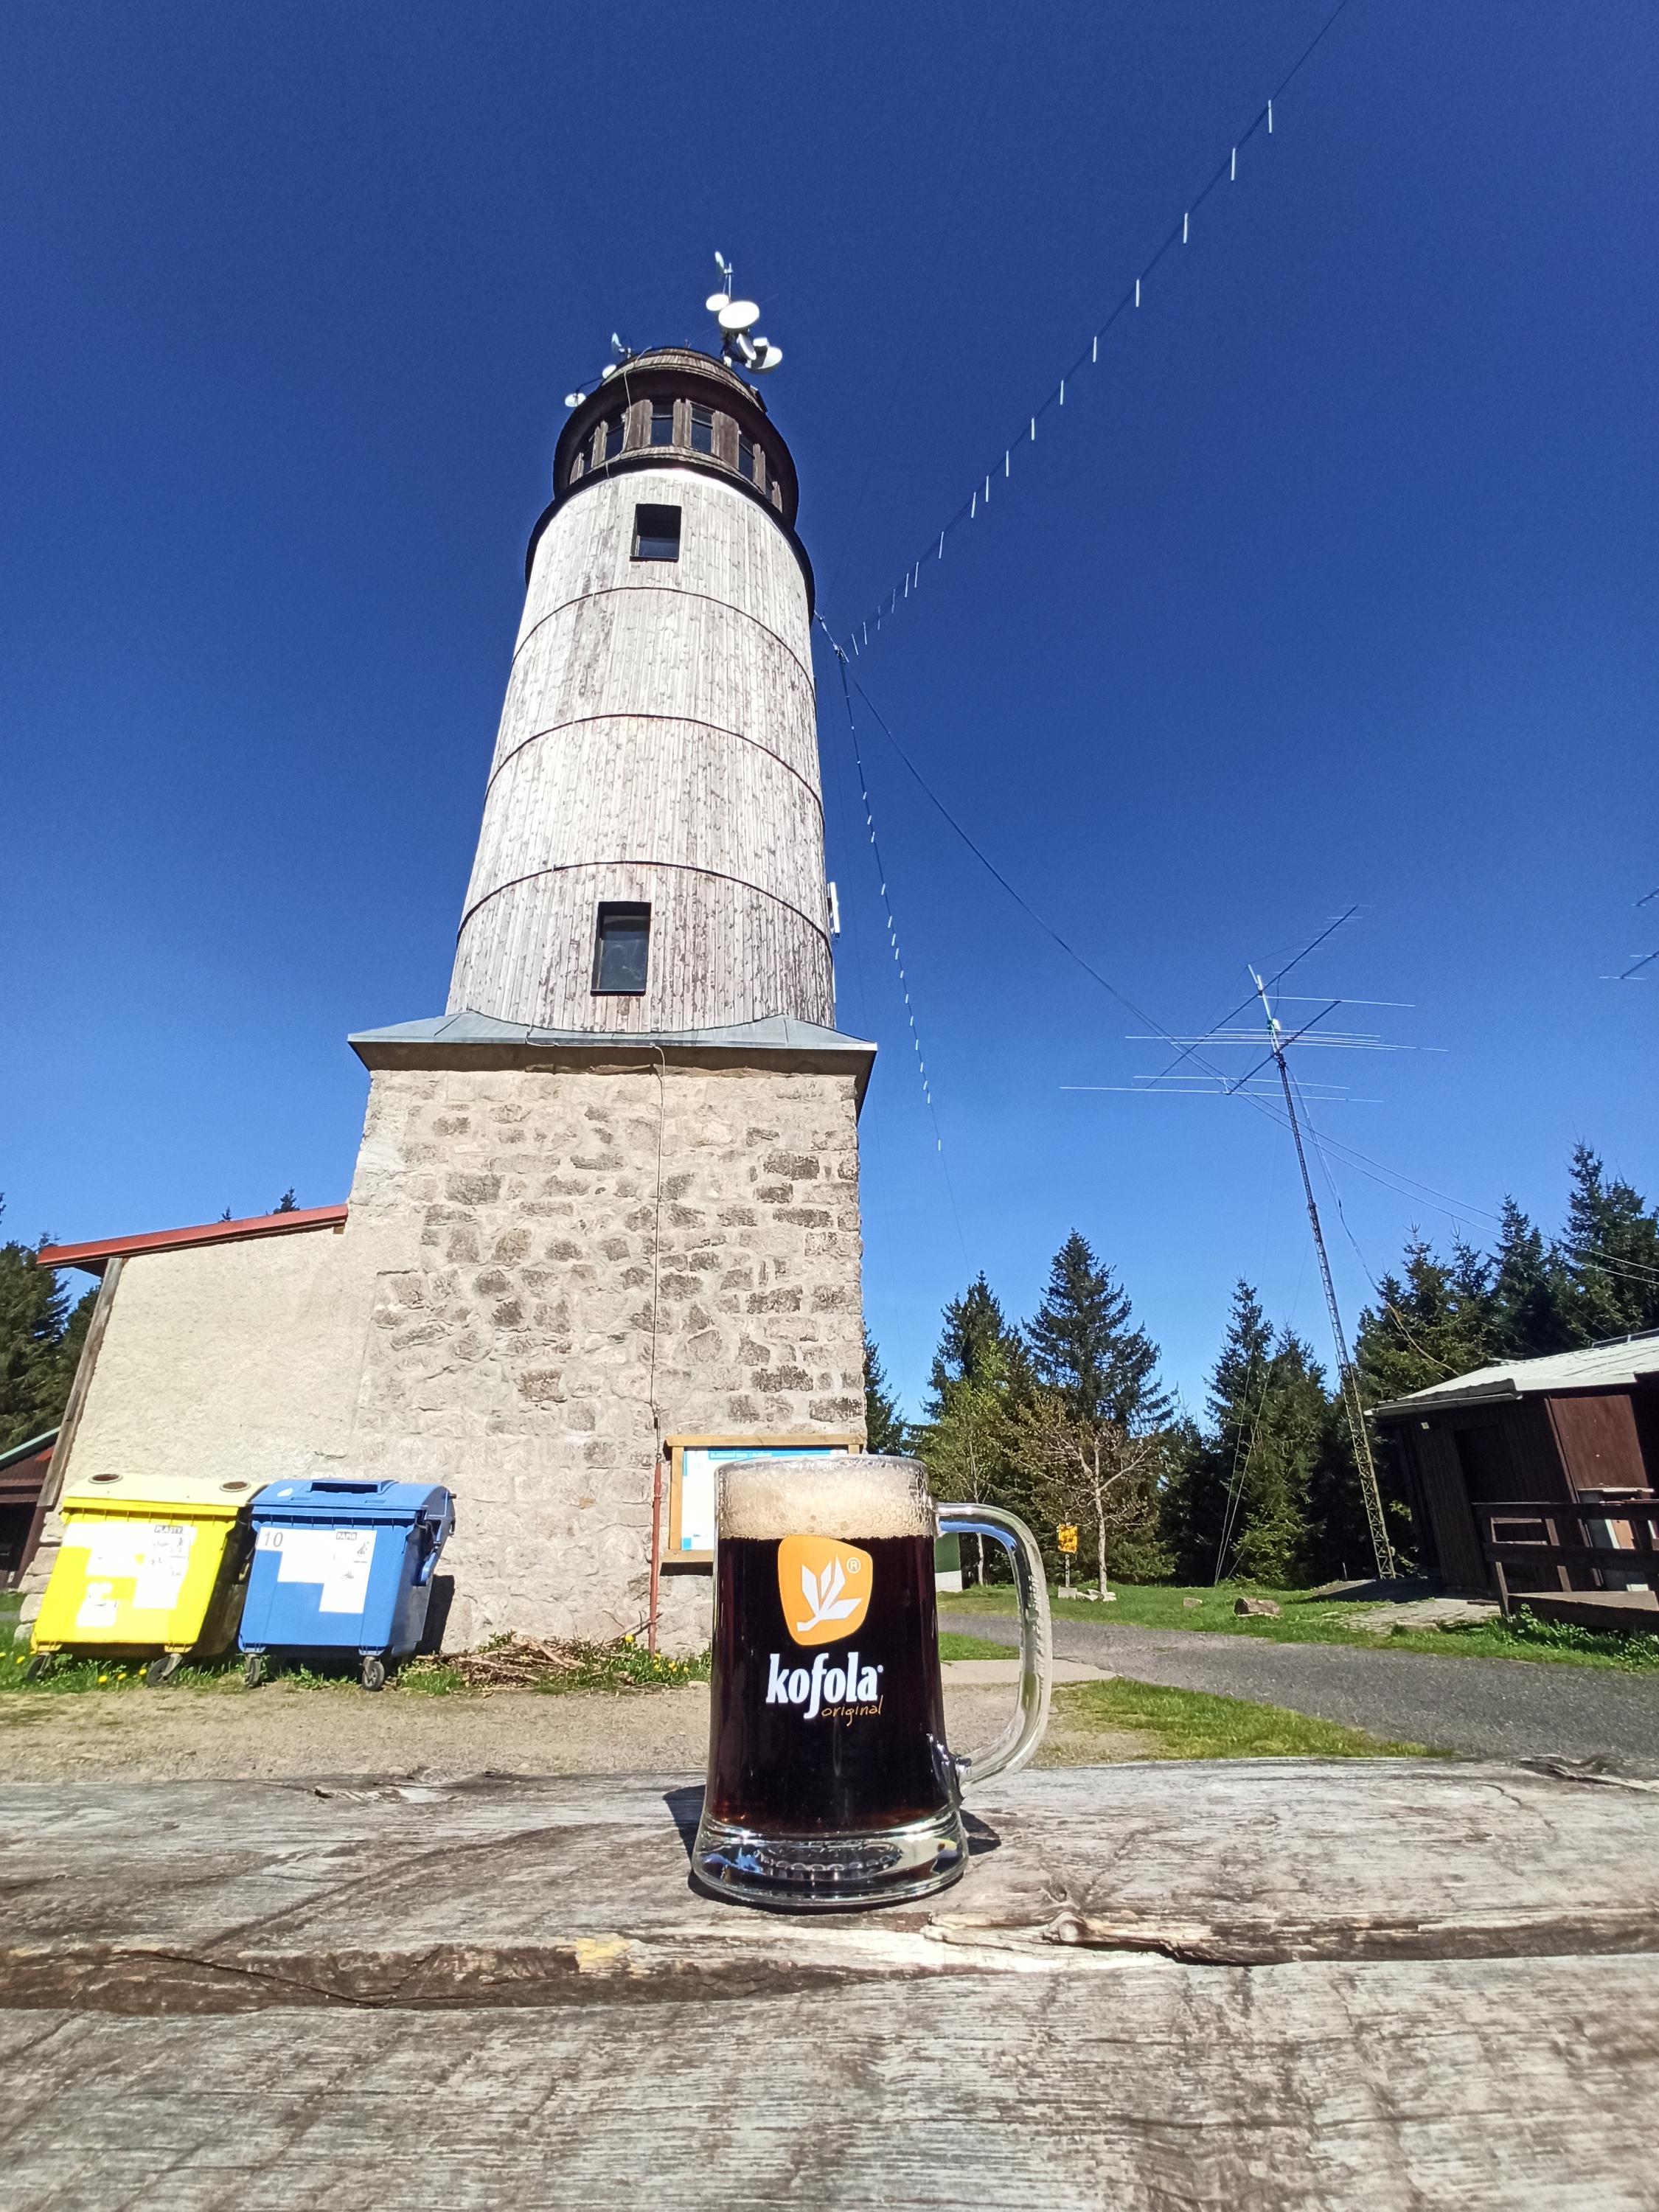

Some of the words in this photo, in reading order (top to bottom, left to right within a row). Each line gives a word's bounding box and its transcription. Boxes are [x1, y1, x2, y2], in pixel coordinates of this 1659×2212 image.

[264, 1531, 284, 1547] 10
[765, 1652, 878, 1719] kofola
[821, 1694, 884, 1727] original
